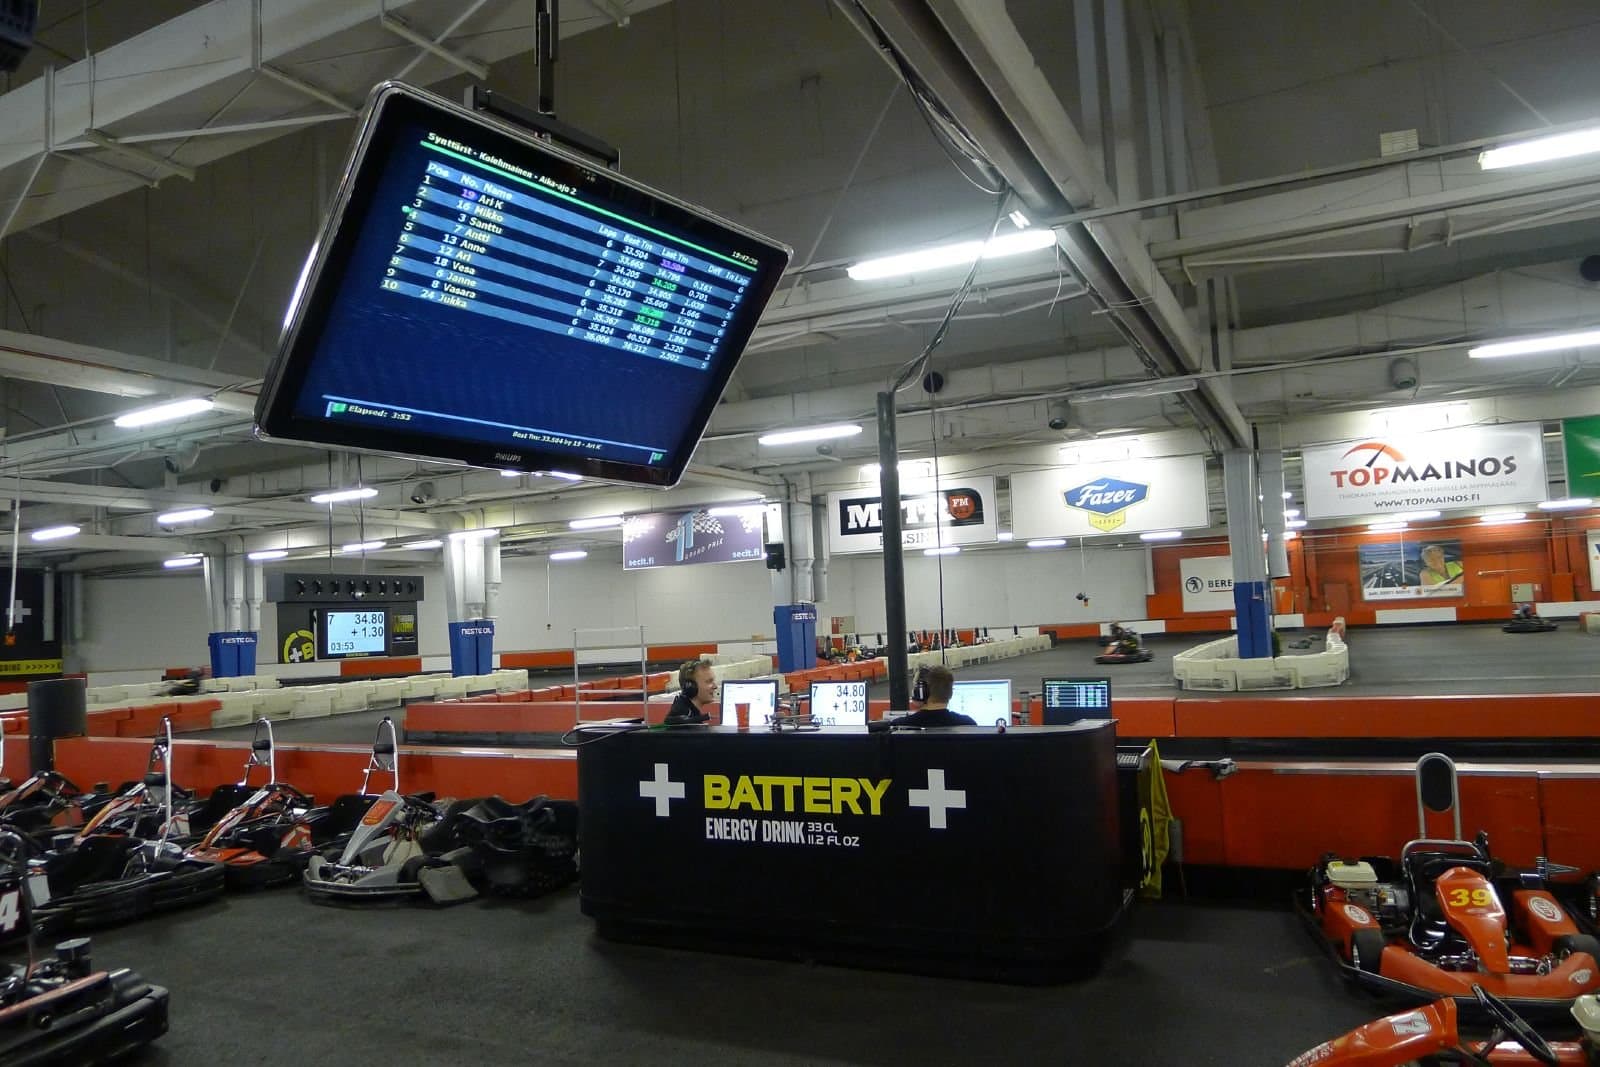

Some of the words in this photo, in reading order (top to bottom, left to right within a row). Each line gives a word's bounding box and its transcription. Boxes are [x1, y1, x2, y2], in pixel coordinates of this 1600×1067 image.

[570, 188, 577, 196] 2
[417, 187, 427, 197] 2
[456, 199, 471, 211] 16
[474, 205, 504, 223] Mikko
[602, 250, 609, 258] 6
[423, 175, 431, 185] 1
[461, 189, 476, 199] 19
[495, 201, 504, 210] K
[622, 245, 649, 260] 33.504
[427, 162, 449, 177] Pos
[461, 175, 478, 188] No.
[483, 183, 513, 200] Name
[599, 225, 617, 238] Laps
[661, 248, 678, 259] Last
[409, 209, 417, 220] 4
[453, 224, 462, 233] 7
[464, 228, 490, 243] Antti
[593, 269, 600, 277] 7
[413, 198, 423, 208] 3
[458, 213, 467, 222] 3
[469, 216, 503, 234] Santtu
[597, 259, 605, 267] 7
[614, 265, 640, 279] 34.205
[688, 290, 708, 302] 0.701
[395, 244, 405, 254] 7
[434, 256, 449, 267] 18
[452, 262, 476, 275] Vesa
[400, 234, 409, 242] 6
[438, 245, 453, 256] 12
[584, 288, 592, 297] 6
[404, 222, 414, 231] 5
[443, 234, 457, 244] 13
[460, 240, 486, 254] Anne
[589, 280, 595, 288] 6
[605, 284, 632, 298] 35.170
[680, 308, 700, 319] 1.666
[391, 257, 400, 265] 8
[435, 269, 444, 278] 6
[446, 272, 477, 287] Janne
[382, 279, 398, 290] 10
[420, 289, 436, 299] 24
[438, 294, 467, 308] Jukka
[386, 268, 396, 277] 9
[431, 280, 440, 288] 8
[443, 283, 476, 299] Vasara
[572, 318, 579, 326] 6
[348, 405, 388, 418] Elapsed:
[1330, 455, 1517, 488] TOPMAINOS
[952, 498, 968, 507] FM
[1075, 482, 1136, 506] Fazer
[1374, 493, 1480, 508] WWW.TOPMAINOS.FI
[628, 557, 655, 567] secit.fi
[732, 548, 760, 559] secit.fi
[328, 615, 334, 625] 7
[354, 614, 384, 625] 34.80
[362, 627, 384, 638] 1.30
[330, 642, 354, 651] 03:53
[812, 686, 818, 697] 7
[837, 685, 865, 697] 34.80
[844, 700, 865, 713] 1.30
[703, 774, 892, 815] BATTERY
[705, 817, 757, 842] ENERGY
[762, 819, 805, 844] DRINK
[807, 822, 822, 832] 33
[823, 822, 838, 833] CL
[807, 834, 824, 845] 11.2
[1450, 888, 1493, 907] 39
